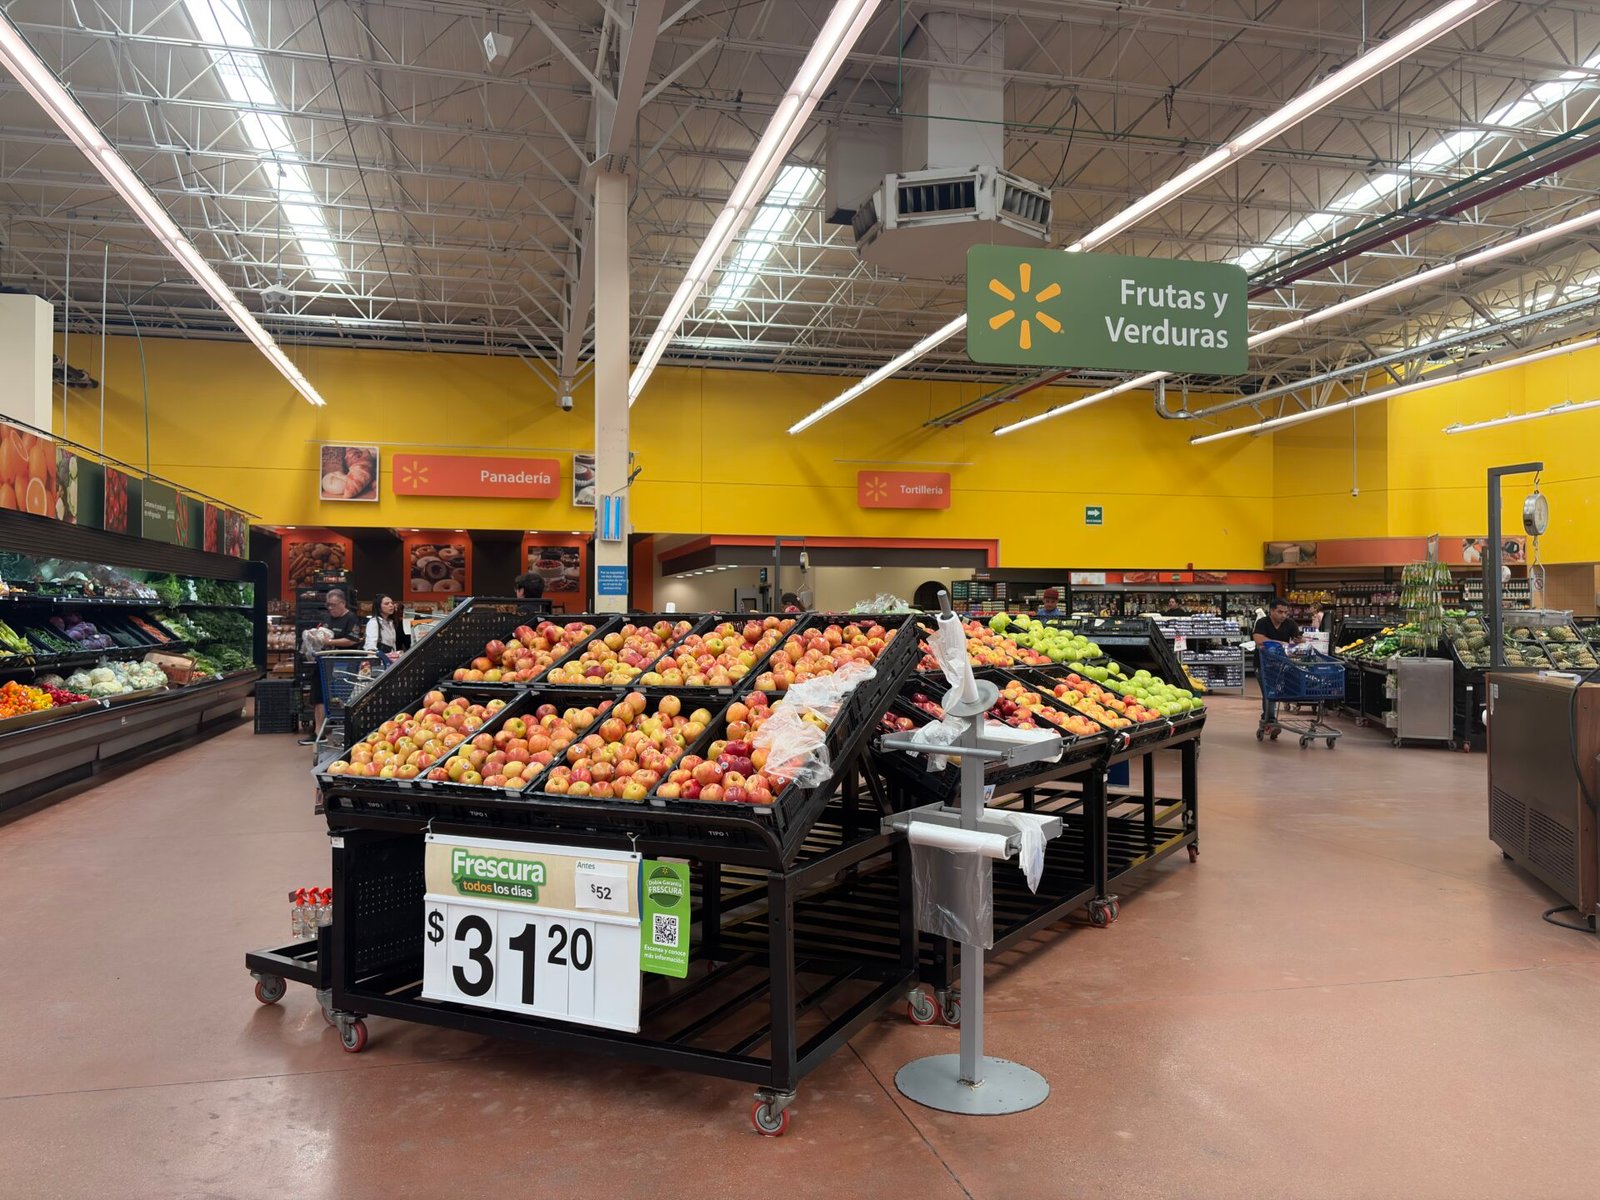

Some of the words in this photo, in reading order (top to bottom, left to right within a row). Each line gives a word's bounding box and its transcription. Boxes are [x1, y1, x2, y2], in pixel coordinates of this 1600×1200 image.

[1120, 278, 1206, 310] Frutas
[1212, 291, 1229, 319] y
[1104, 315, 1229, 349] Verduras
[480, 469, 551, 485] Panadería
[899, 484, 944, 495] Tortillería
[453, 850, 544, 883] Frescura
[576, 861, 596, 870] Antes
[463, 881, 492, 893] todos
[493, 882, 509, 895] los
[511, 885, 533, 898] días
[648, 885, 683, 895] FRESCURA
